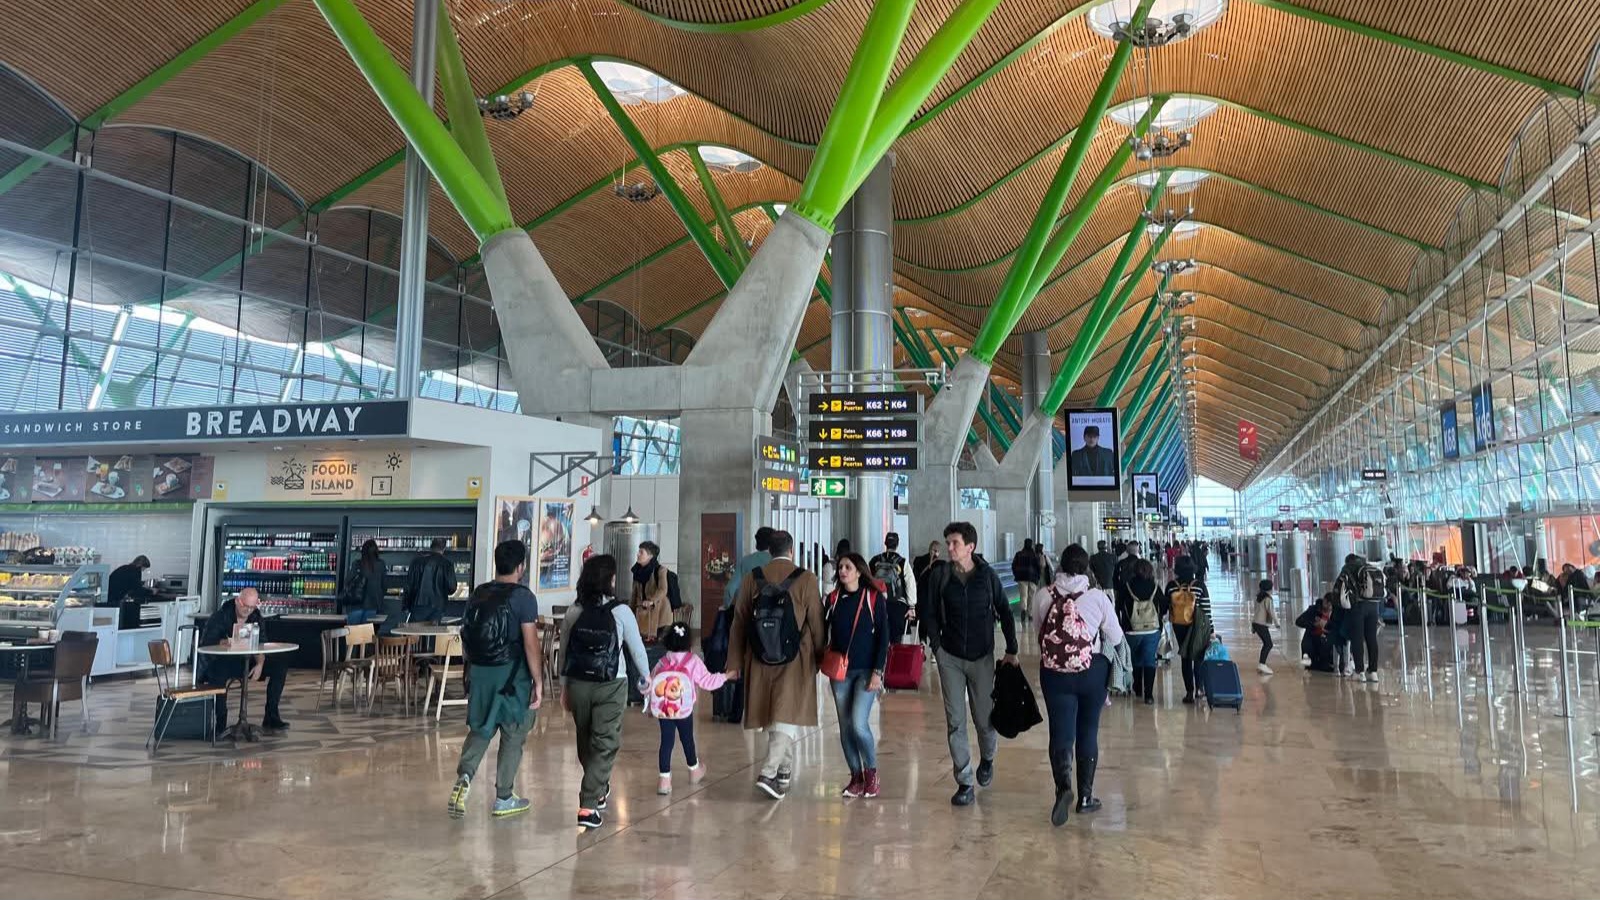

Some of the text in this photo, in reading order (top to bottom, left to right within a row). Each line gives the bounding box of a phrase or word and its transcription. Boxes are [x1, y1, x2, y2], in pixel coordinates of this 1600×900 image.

[866, 401, 882, 409] K62
[891, 400, 907, 409] K64
[186, 407, 362, 436] BREADWAY
[4, 421, 142, 434] SANDWICH STORE
[866, 430, 882, 438] K66
[891, 429, 907, 438] K98
[866, 457, 882, 466] K69
[891, 457, 906, 465] K71
[311, 463, 358, 476] FOODIE
[311, 479, 354, 490] ISLAND
